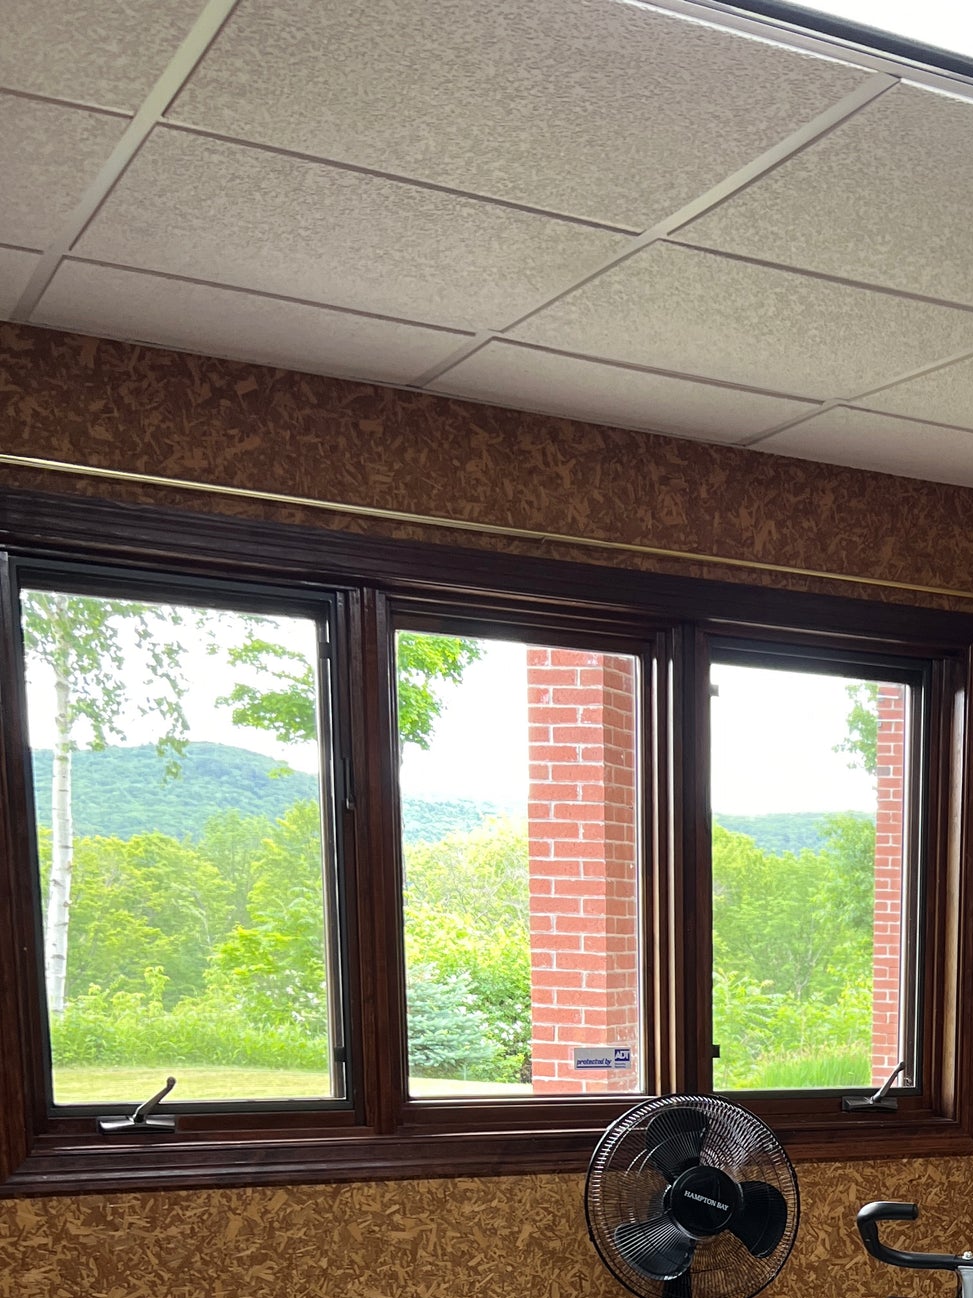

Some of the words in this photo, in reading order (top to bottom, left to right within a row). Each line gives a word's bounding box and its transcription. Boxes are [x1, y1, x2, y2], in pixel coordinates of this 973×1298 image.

[615, 1050, 630, 1060] ADT
[577, 1058, 604, 1066] protected
[605, 1058, 612, 1066] by
[684, 1190, 716, 1207] HAMPTON
[717, 1202, 729, 1211] BAY
